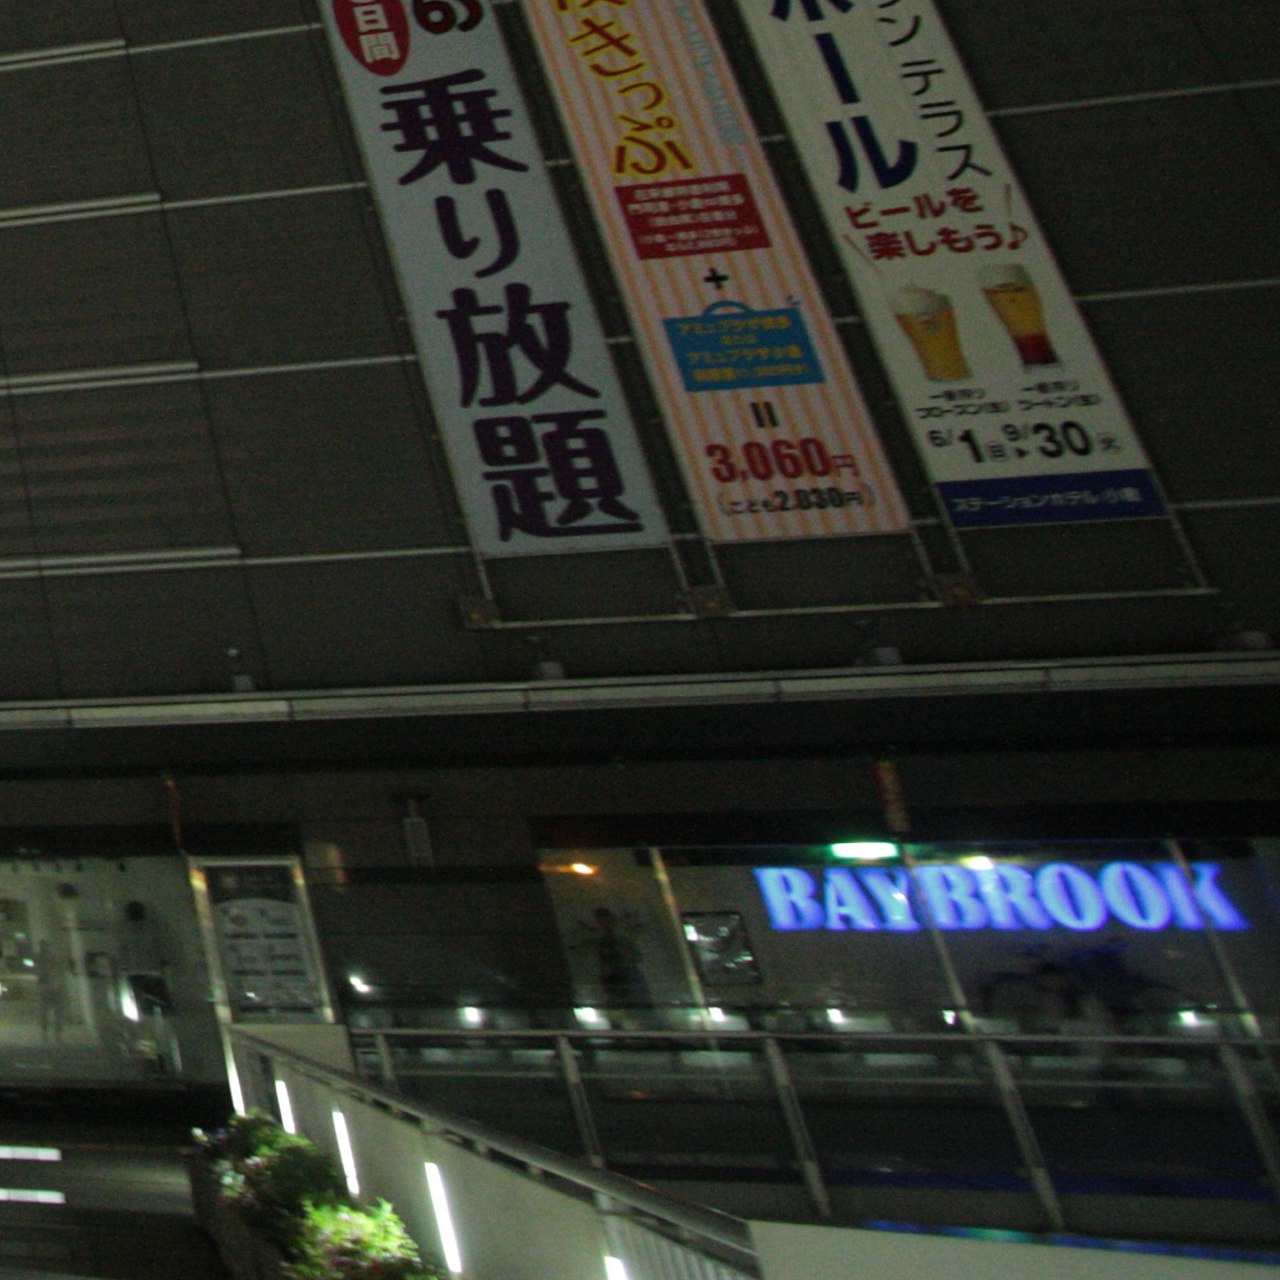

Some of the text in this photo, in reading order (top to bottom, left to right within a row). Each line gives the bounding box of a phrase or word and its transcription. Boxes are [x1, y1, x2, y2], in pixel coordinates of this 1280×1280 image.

[844, 187, 984, 229] ビールを
[380, 66, 645, 543] 乗り放題
[751, 859, 1254, 934] BAYBROOK
